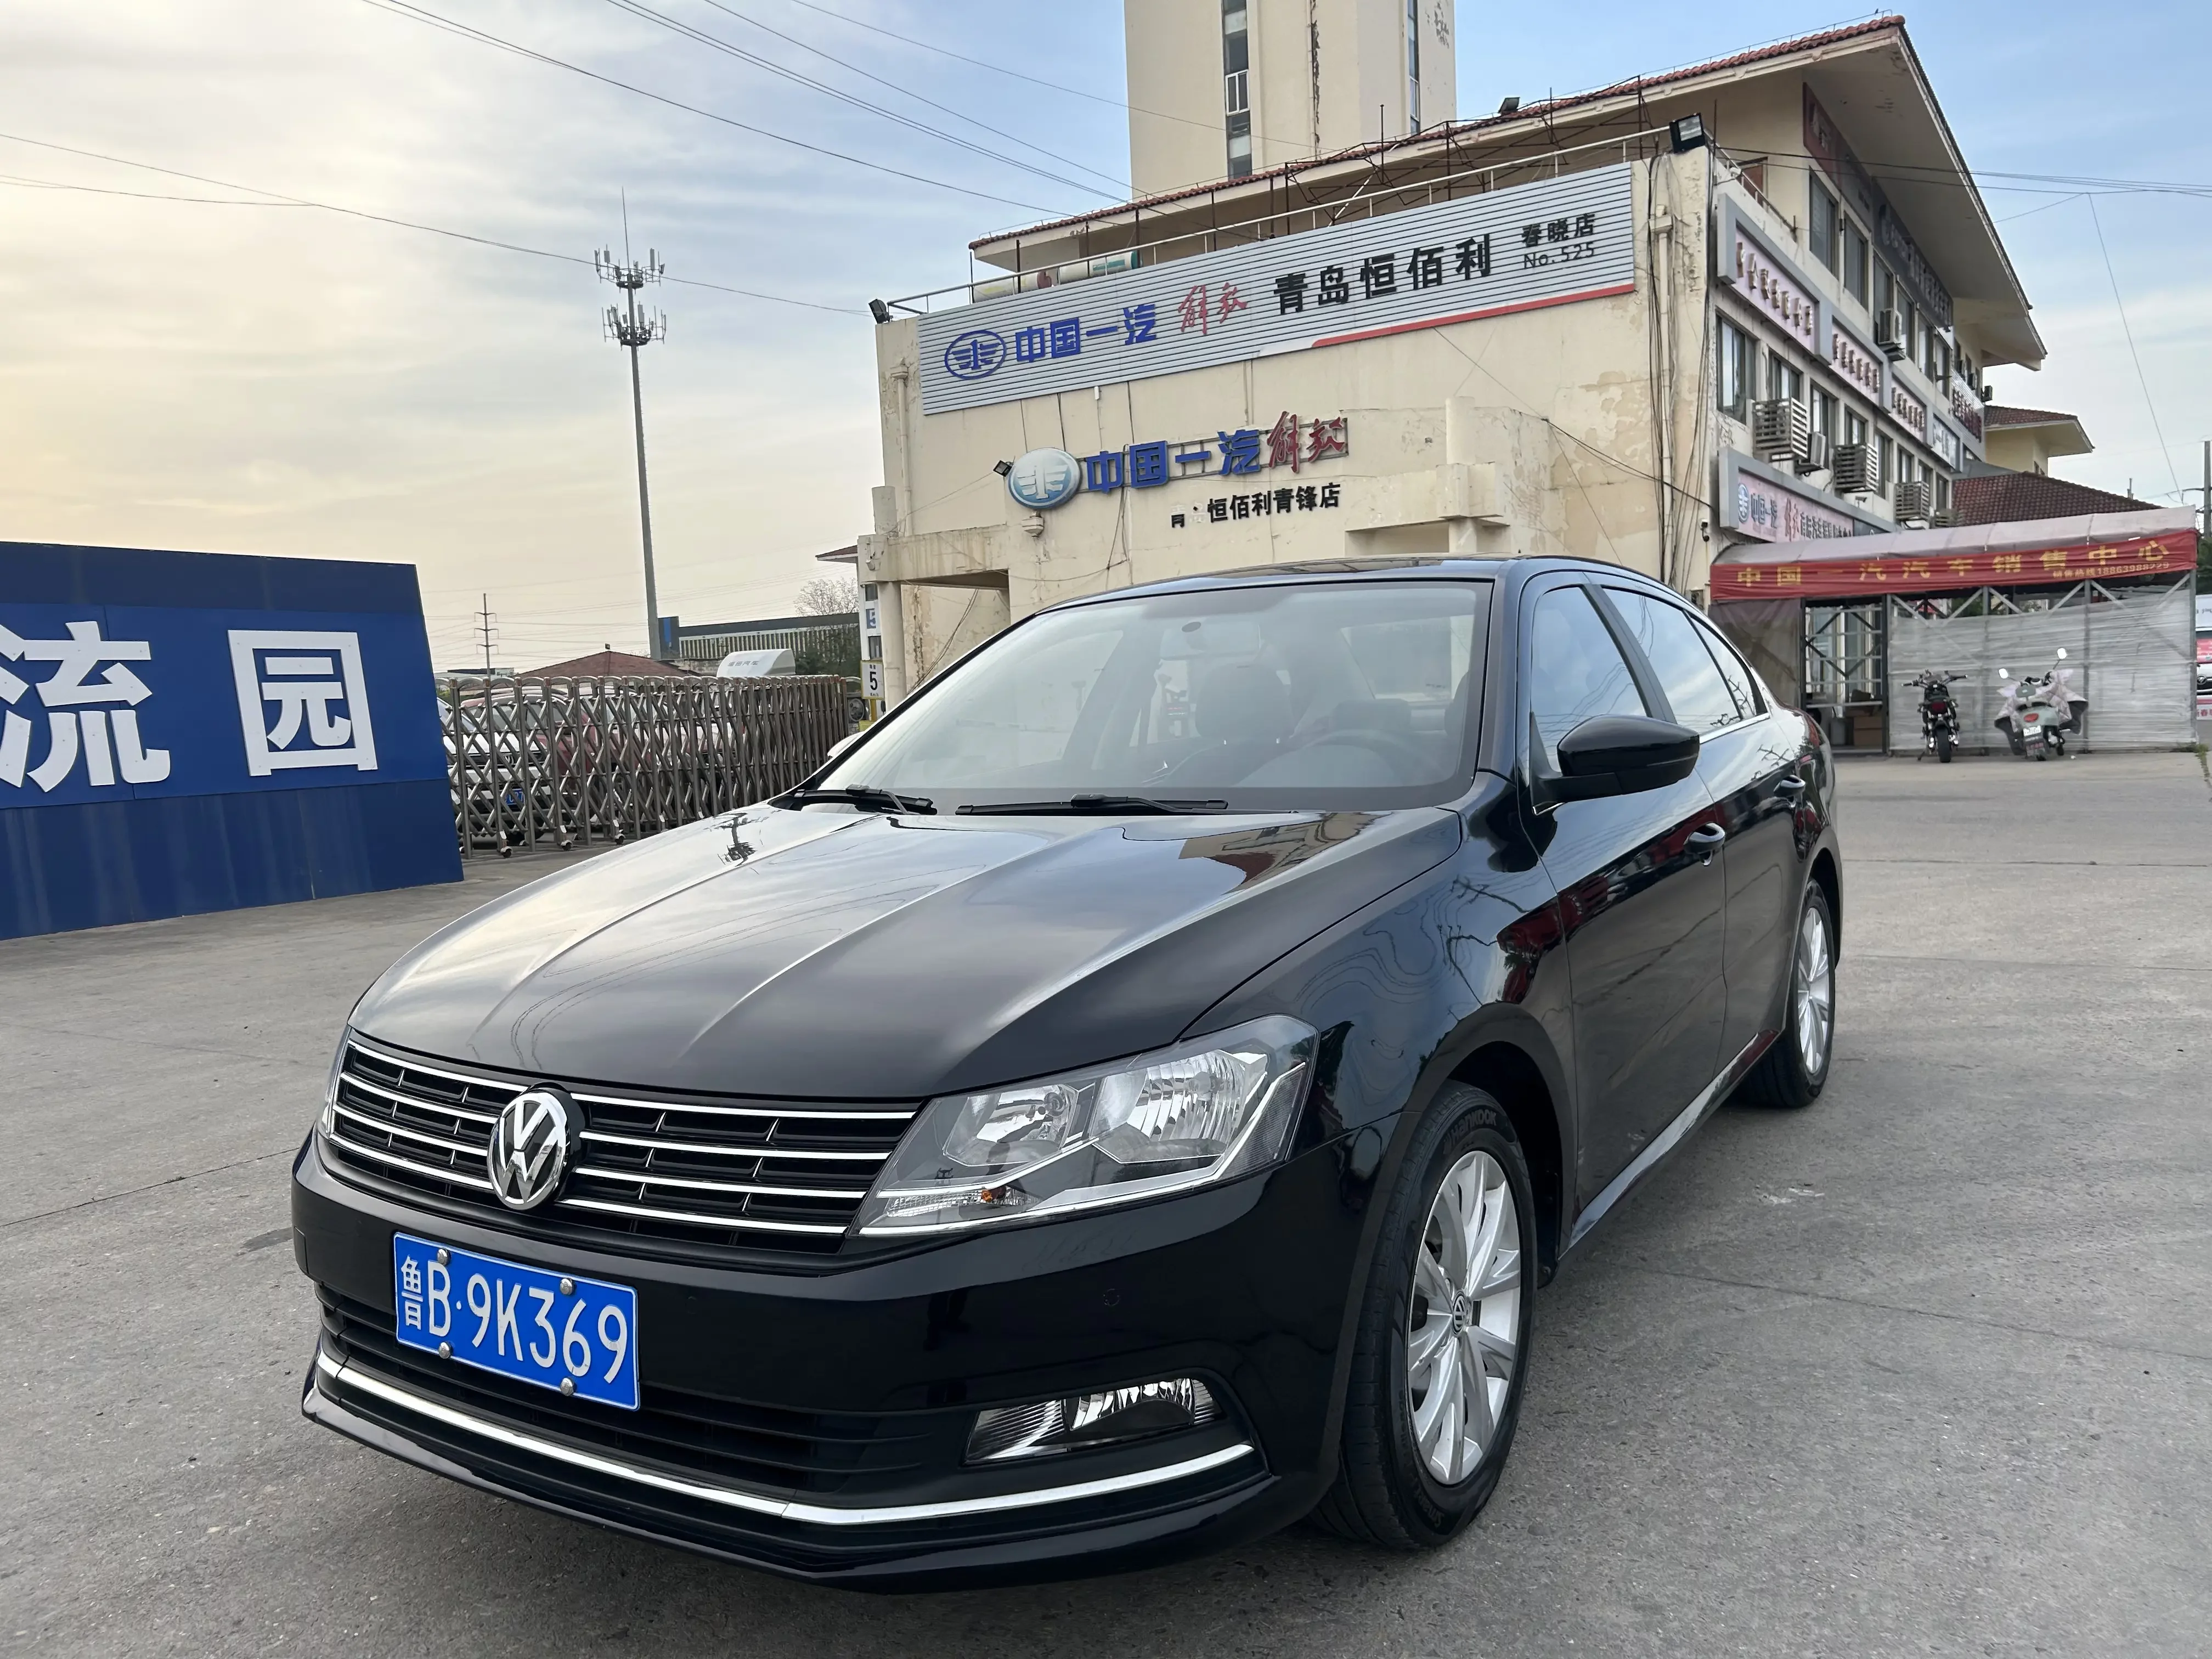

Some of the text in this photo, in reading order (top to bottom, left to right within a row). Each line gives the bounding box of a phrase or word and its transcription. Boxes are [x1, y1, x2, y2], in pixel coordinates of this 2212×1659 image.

[1521, 213, 1595, 247] 春晓店
[1015, 304, 1156, 363] 中国一汽
[1273, 234, 1491, 315] 青岛恒佰利
[1086, 429, 1261, 494] 中国一汽
[870, 671, 878, 691] 5
